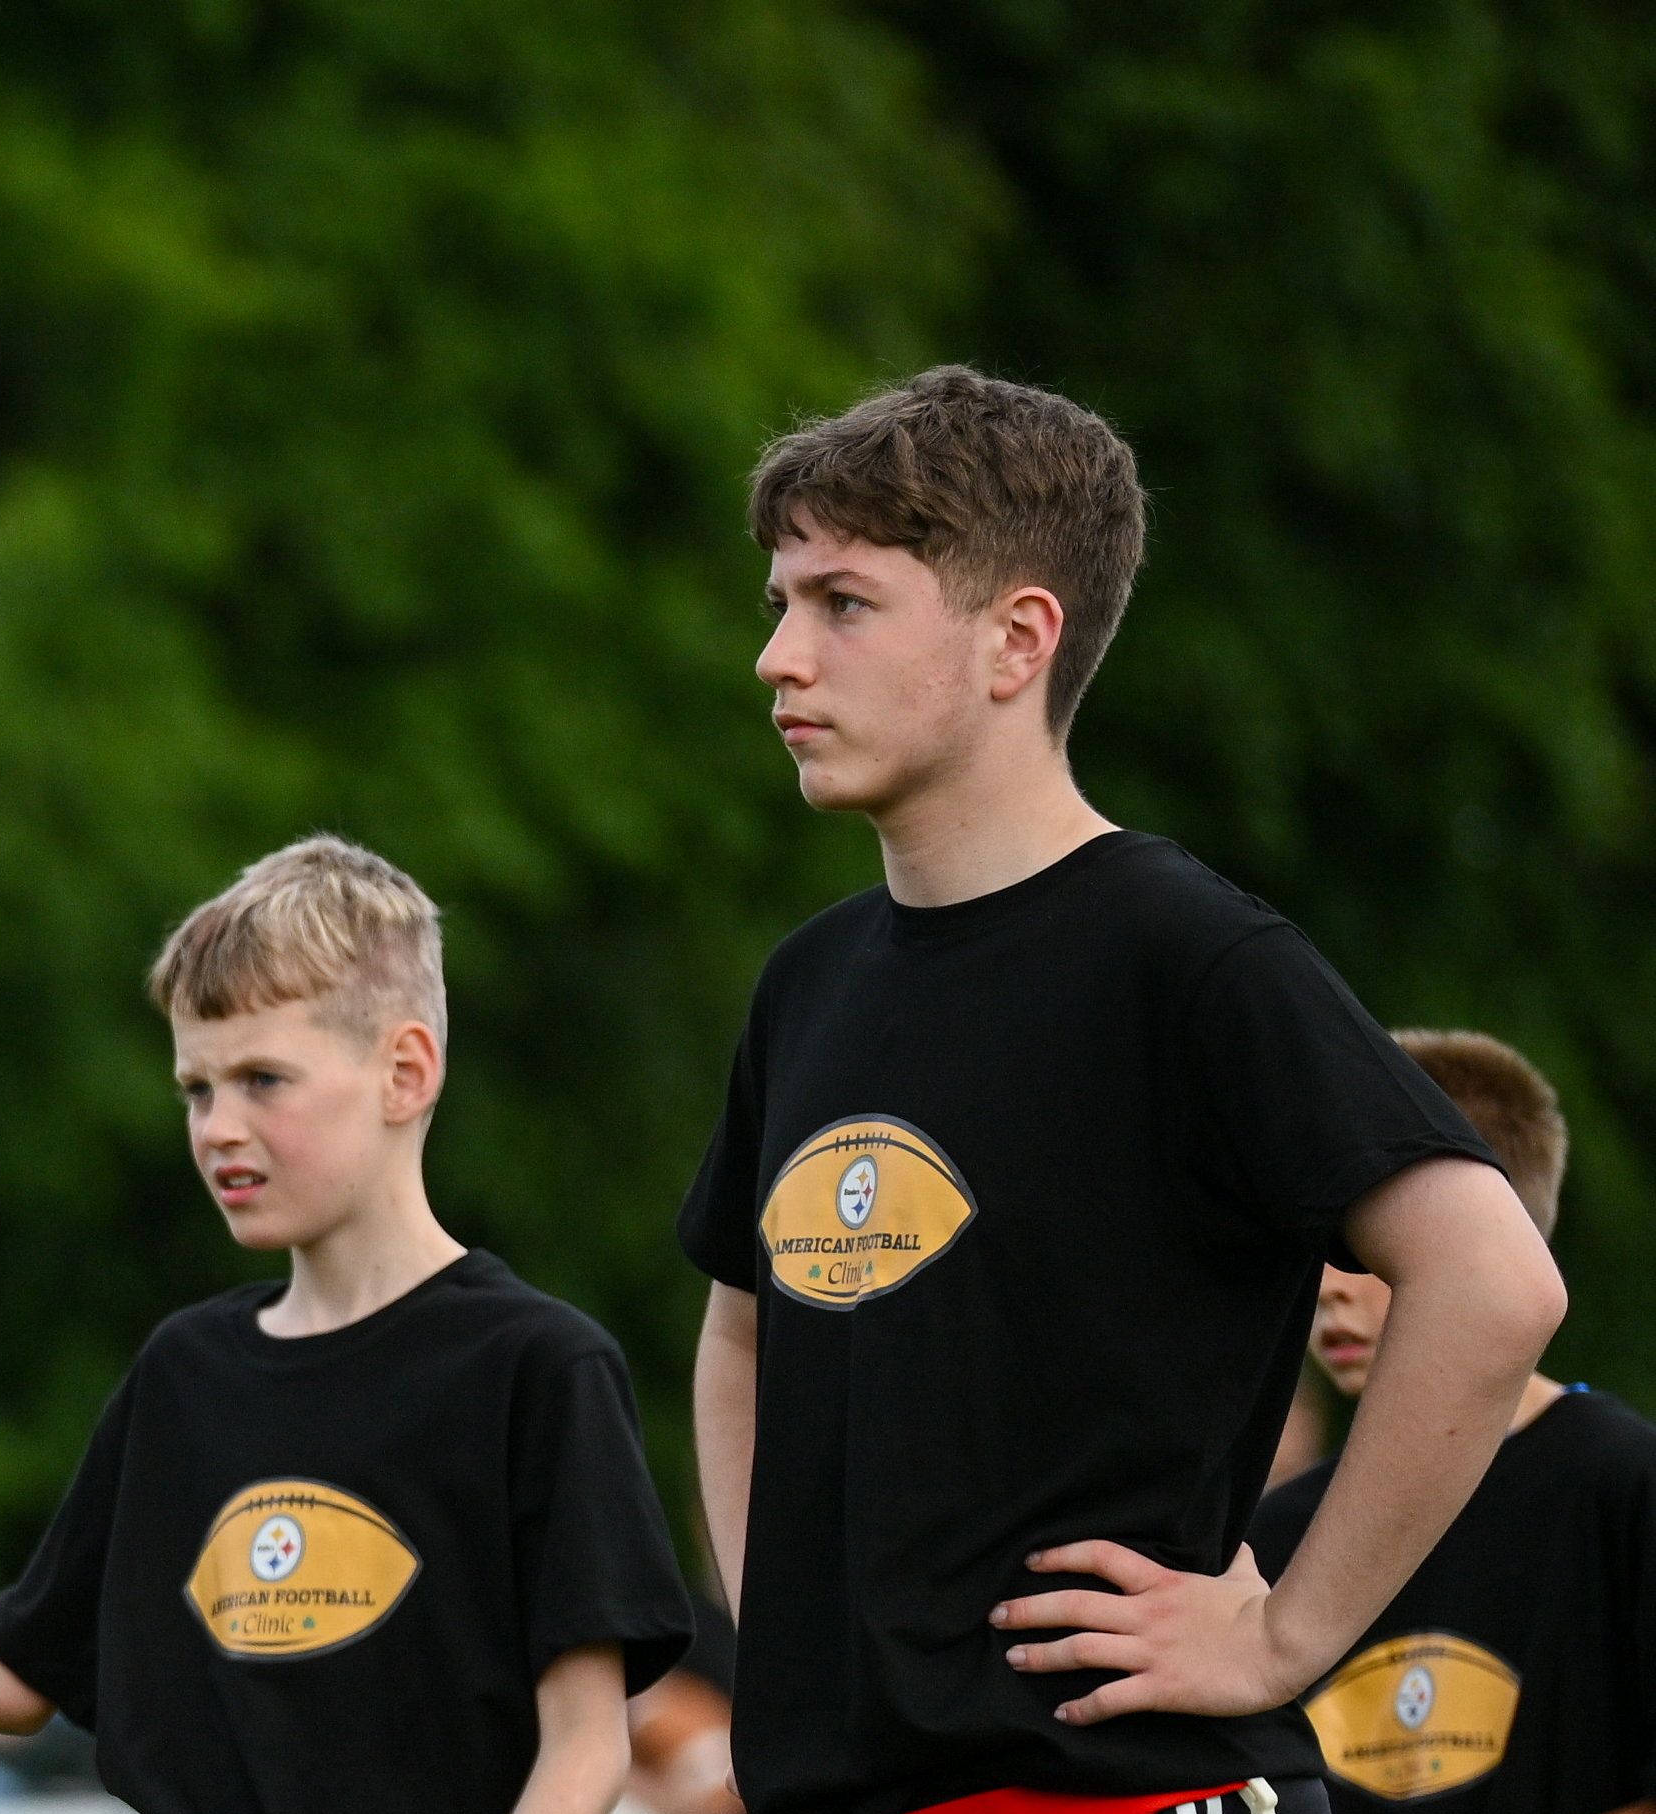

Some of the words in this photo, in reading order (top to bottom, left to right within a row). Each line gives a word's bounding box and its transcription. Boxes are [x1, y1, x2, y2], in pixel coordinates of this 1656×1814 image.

[774, 1237, 854, 1256] AMERICAN
[856, 1233, 921, 1251] FOOTBALL
[211, 1589, 271, 1617] AMERICAN
[273, 1588, 377, 1607] FOOTBALL
[242, 1612, 295, 1635] Clinic
